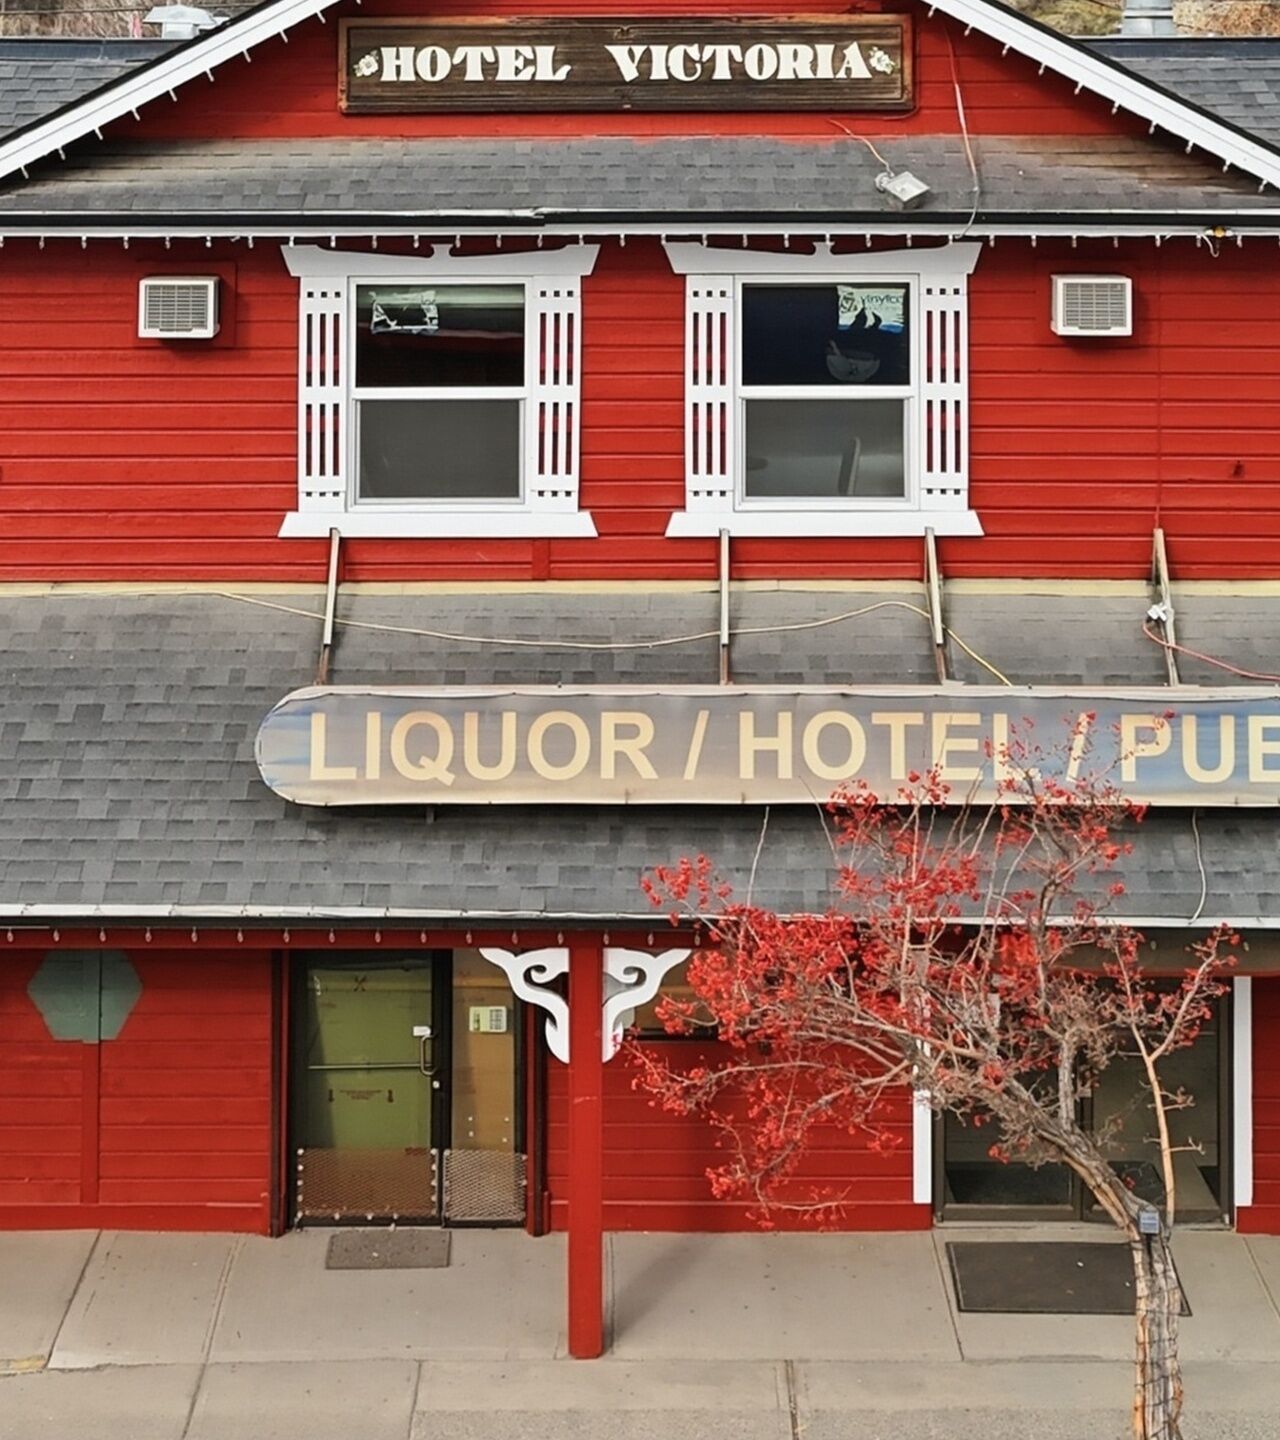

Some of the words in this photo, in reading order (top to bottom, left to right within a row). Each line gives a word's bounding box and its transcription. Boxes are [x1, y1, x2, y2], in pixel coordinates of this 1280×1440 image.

[378, 44, 572, 83] HOTEL
[604, 40, 873, 83] VICTORIA
[309, 710, 659, 786] LIQUOR
[683, 710, 710, 781] /
[738, 710, 1042, 782] HOTEL
